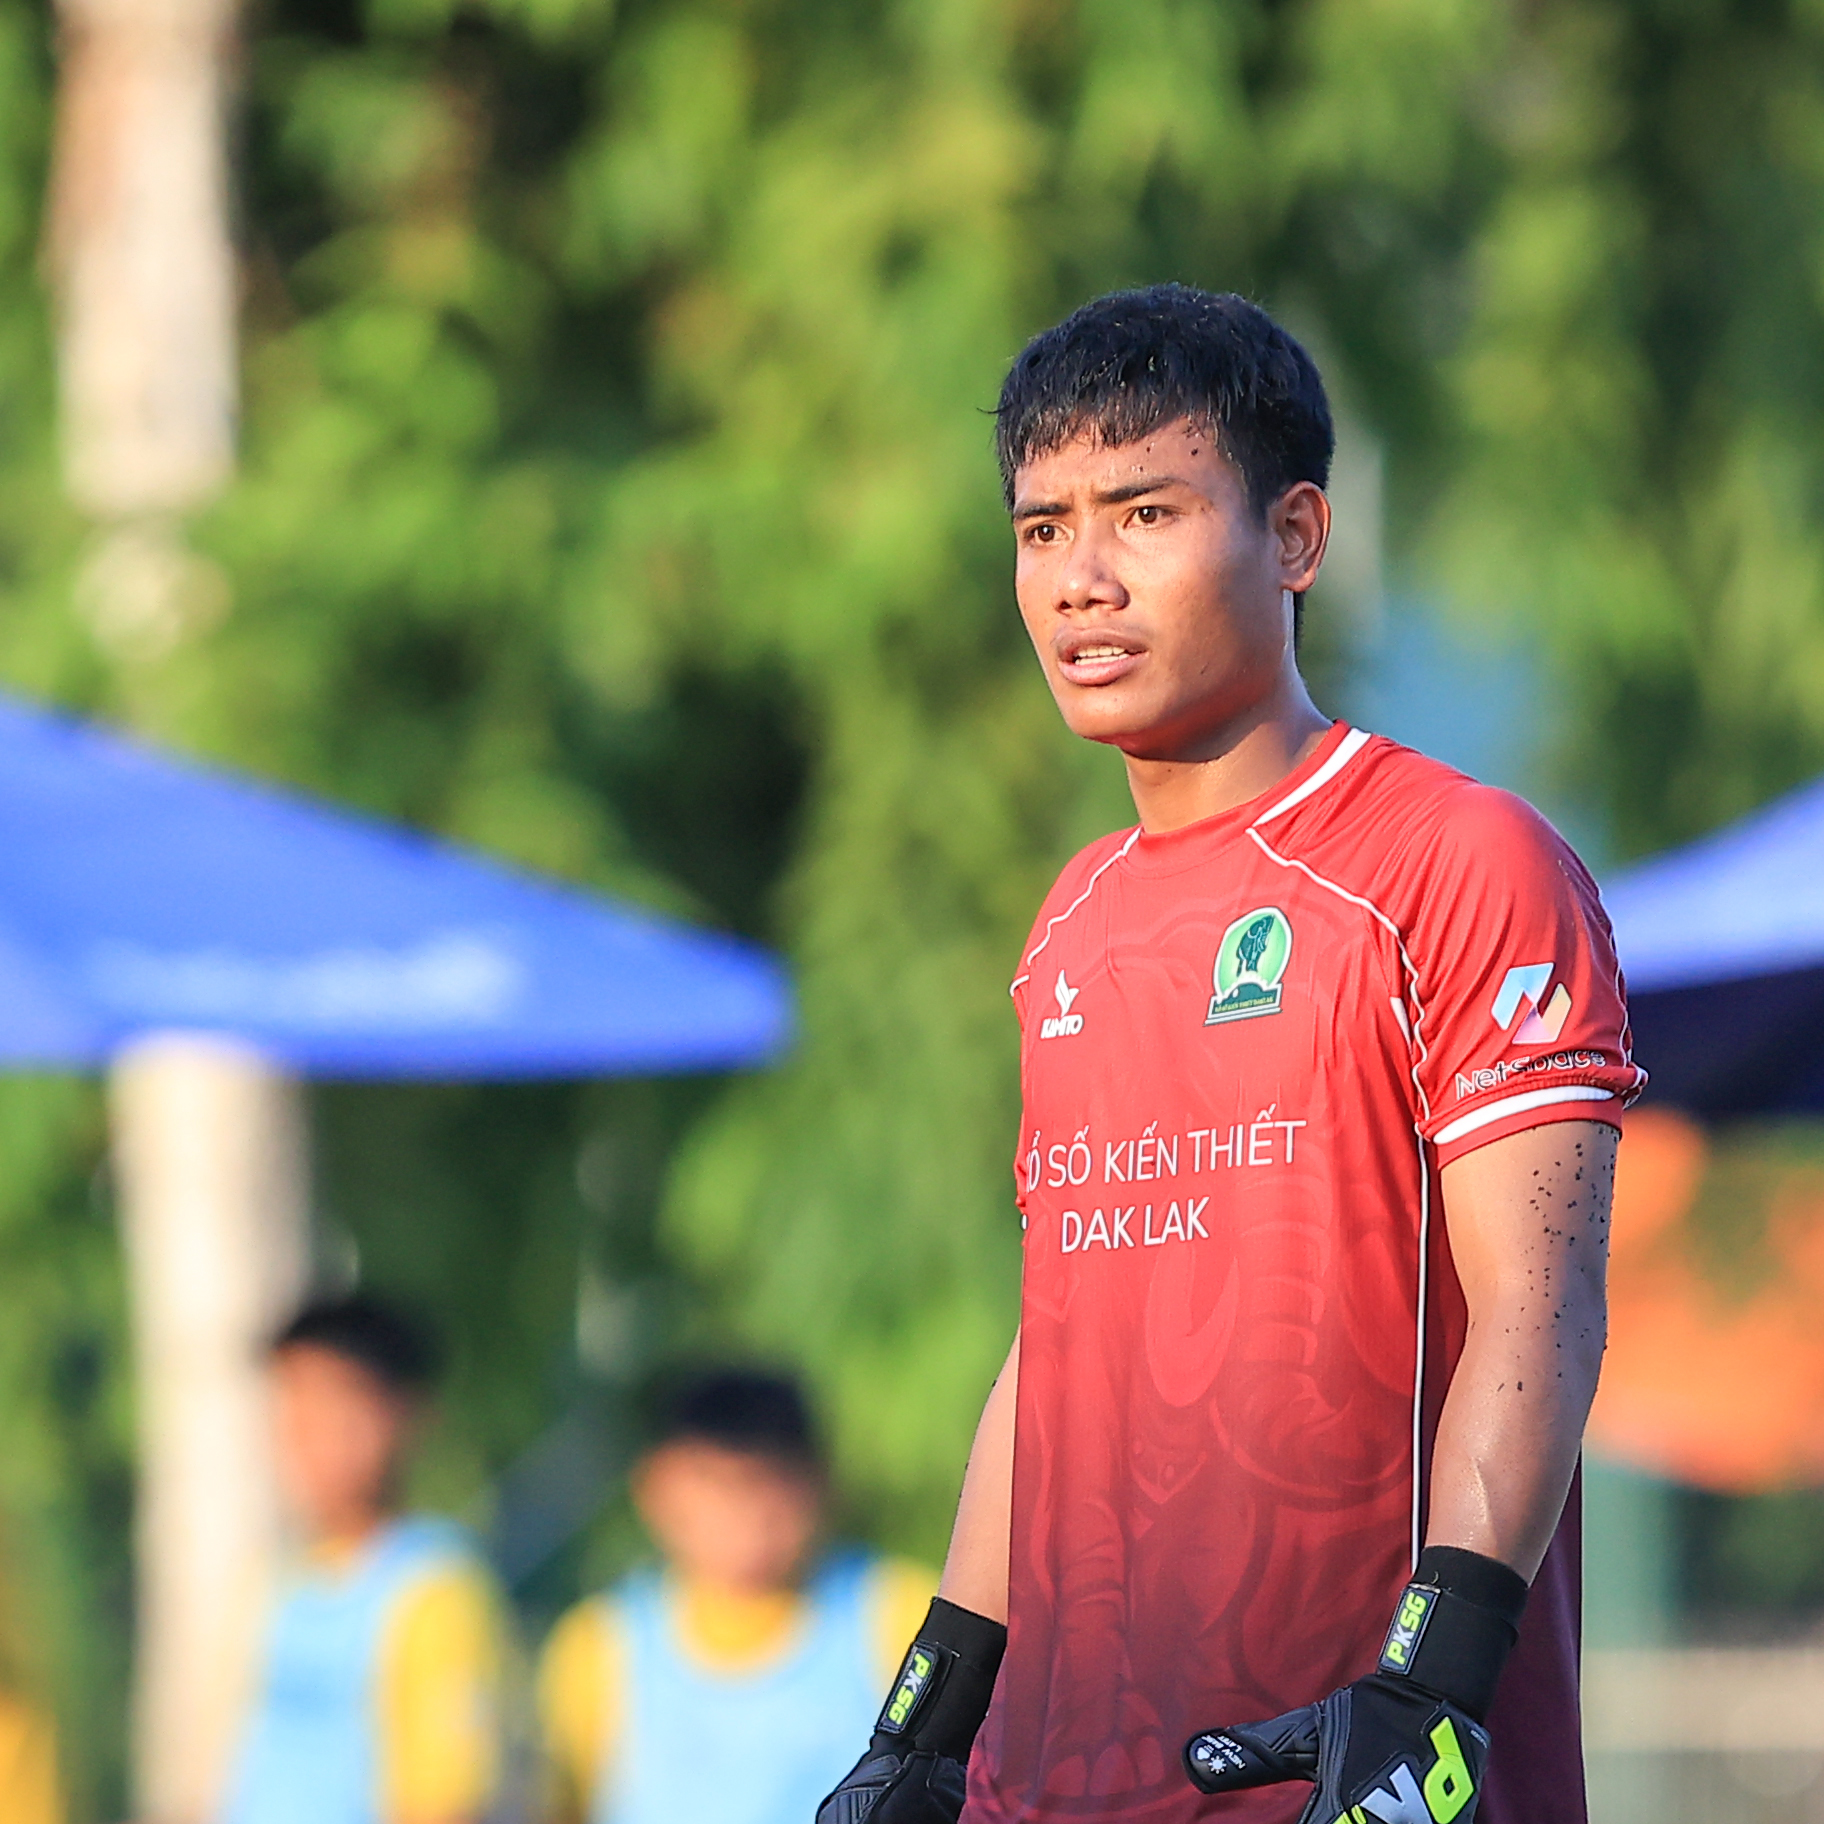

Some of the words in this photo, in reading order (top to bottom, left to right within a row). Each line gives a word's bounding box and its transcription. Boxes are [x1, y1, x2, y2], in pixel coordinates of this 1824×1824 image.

[1046, 1124, 1093, 1189] SỐ
[1103, 1119, 1180, 1184] KIẾN
[1186, 1102, 1308, 1173] THIẾT
[1060, 1205, 1137, 1254] DAK
[1142, 1196, 1211, 1247] LAK
[1385, 1591, 1428, 1667] PKSG
[886, 1652, 933, 1726] PKSG
